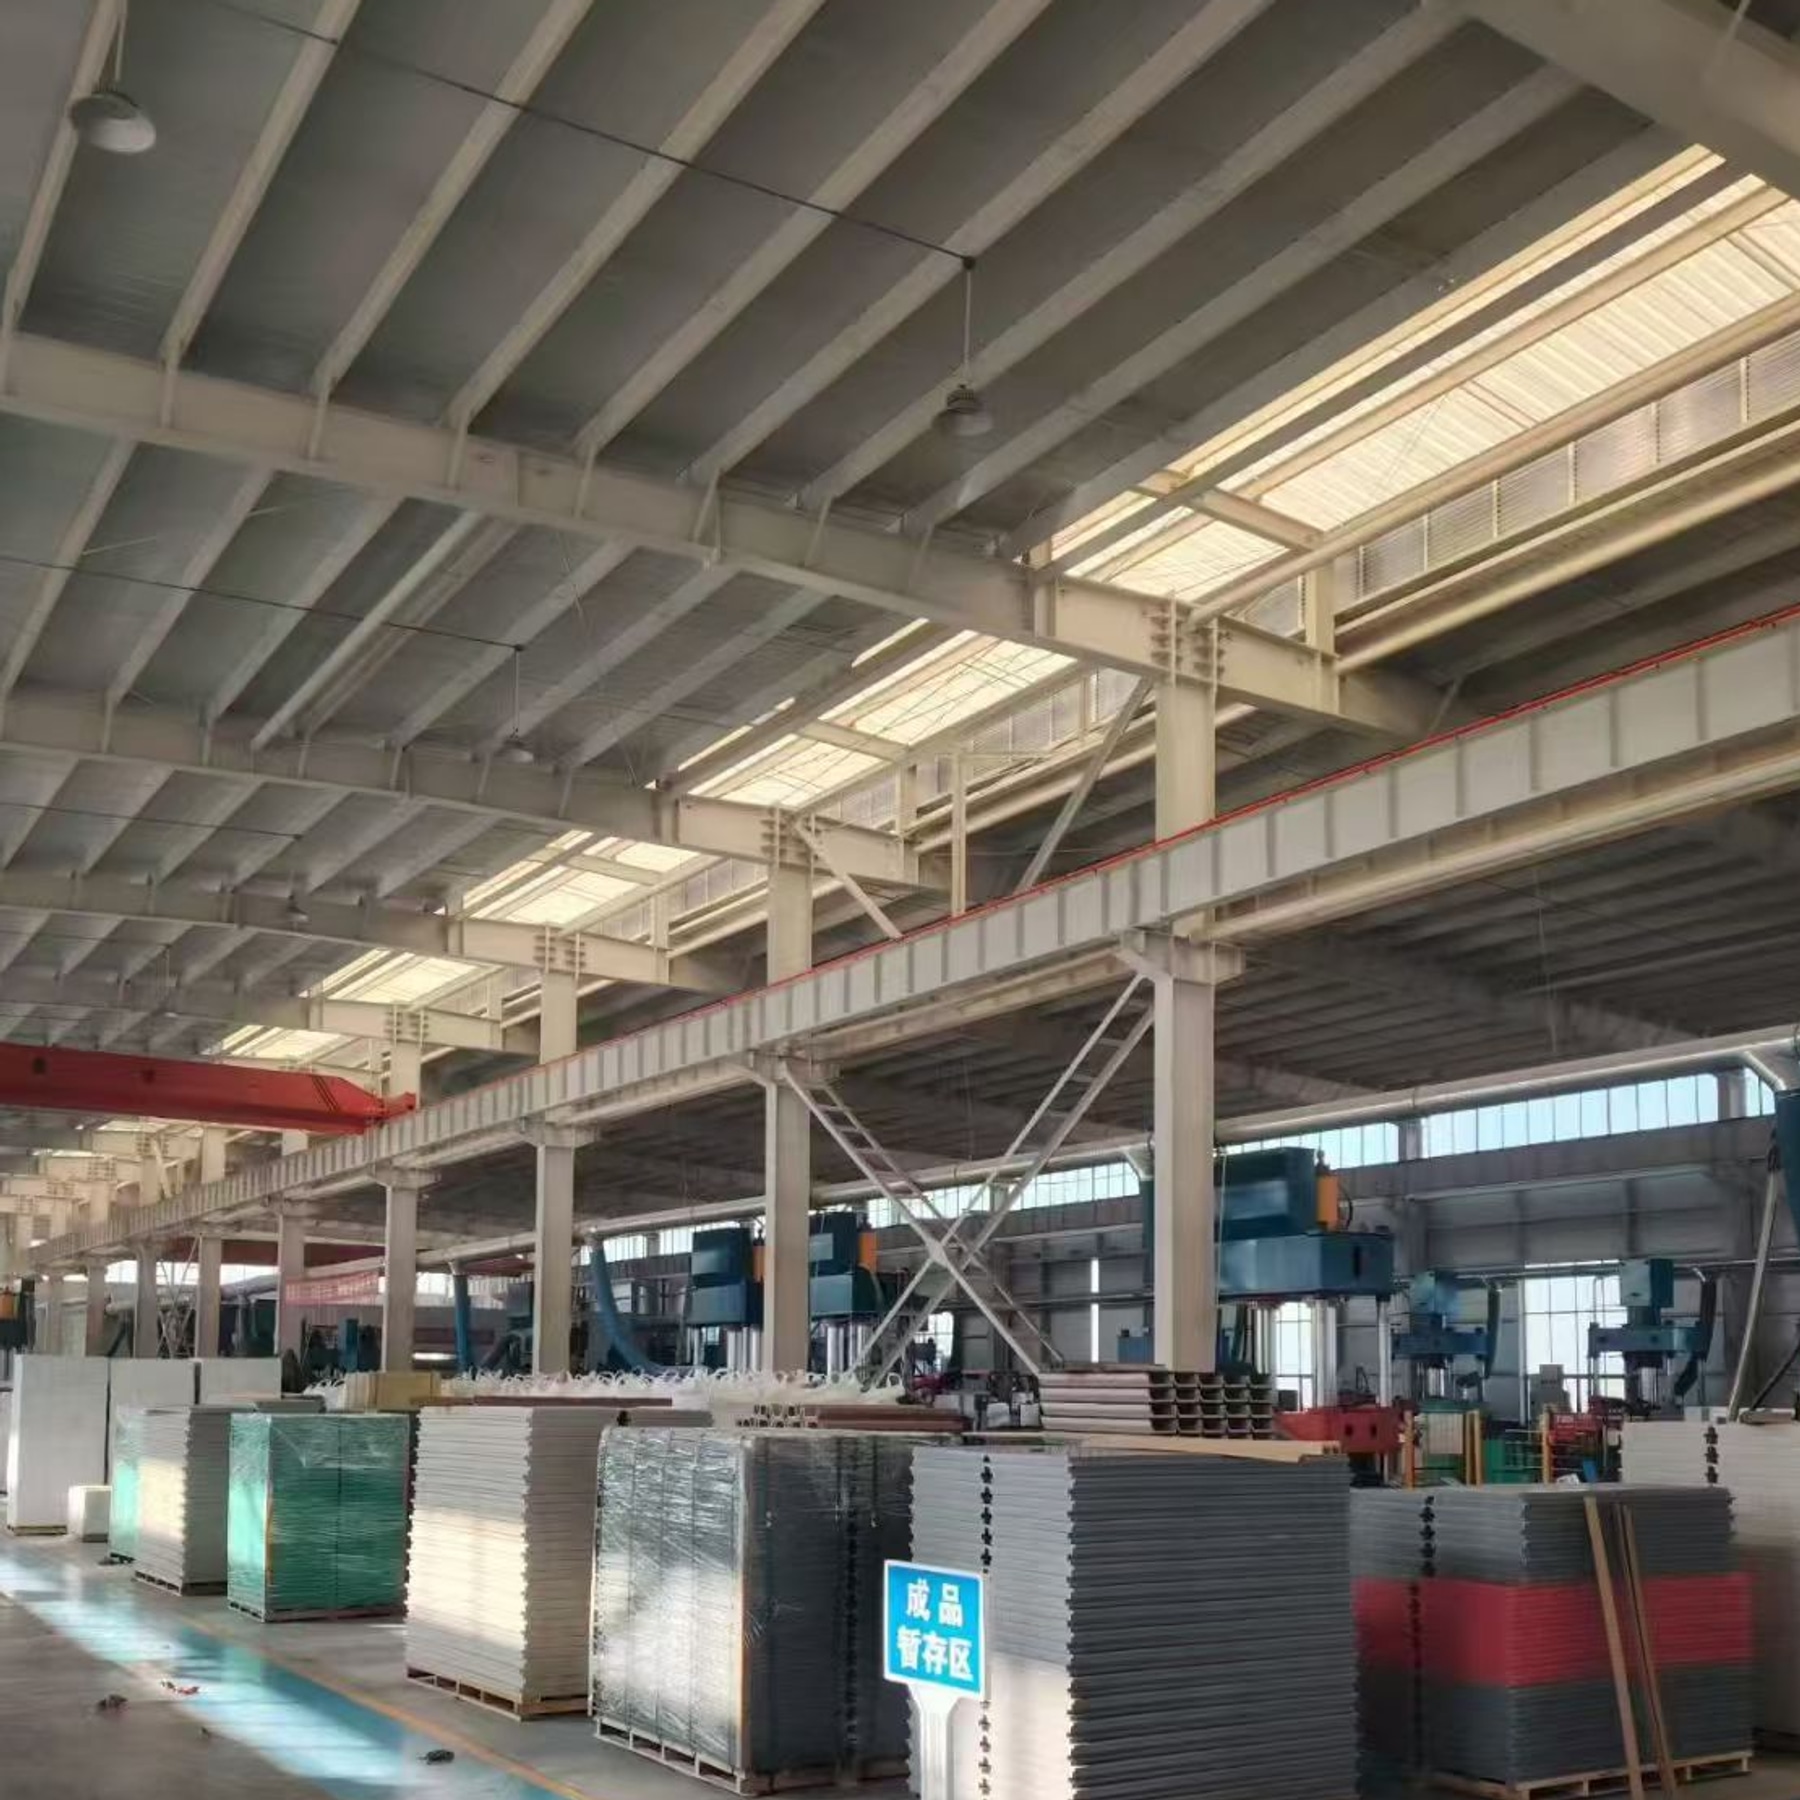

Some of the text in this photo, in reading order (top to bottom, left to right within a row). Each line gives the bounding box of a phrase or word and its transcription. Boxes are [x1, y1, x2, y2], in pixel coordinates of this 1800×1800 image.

[906, 1577, 964, 1628] 成品
[897, 1624, 974, 1682] 暂存区
